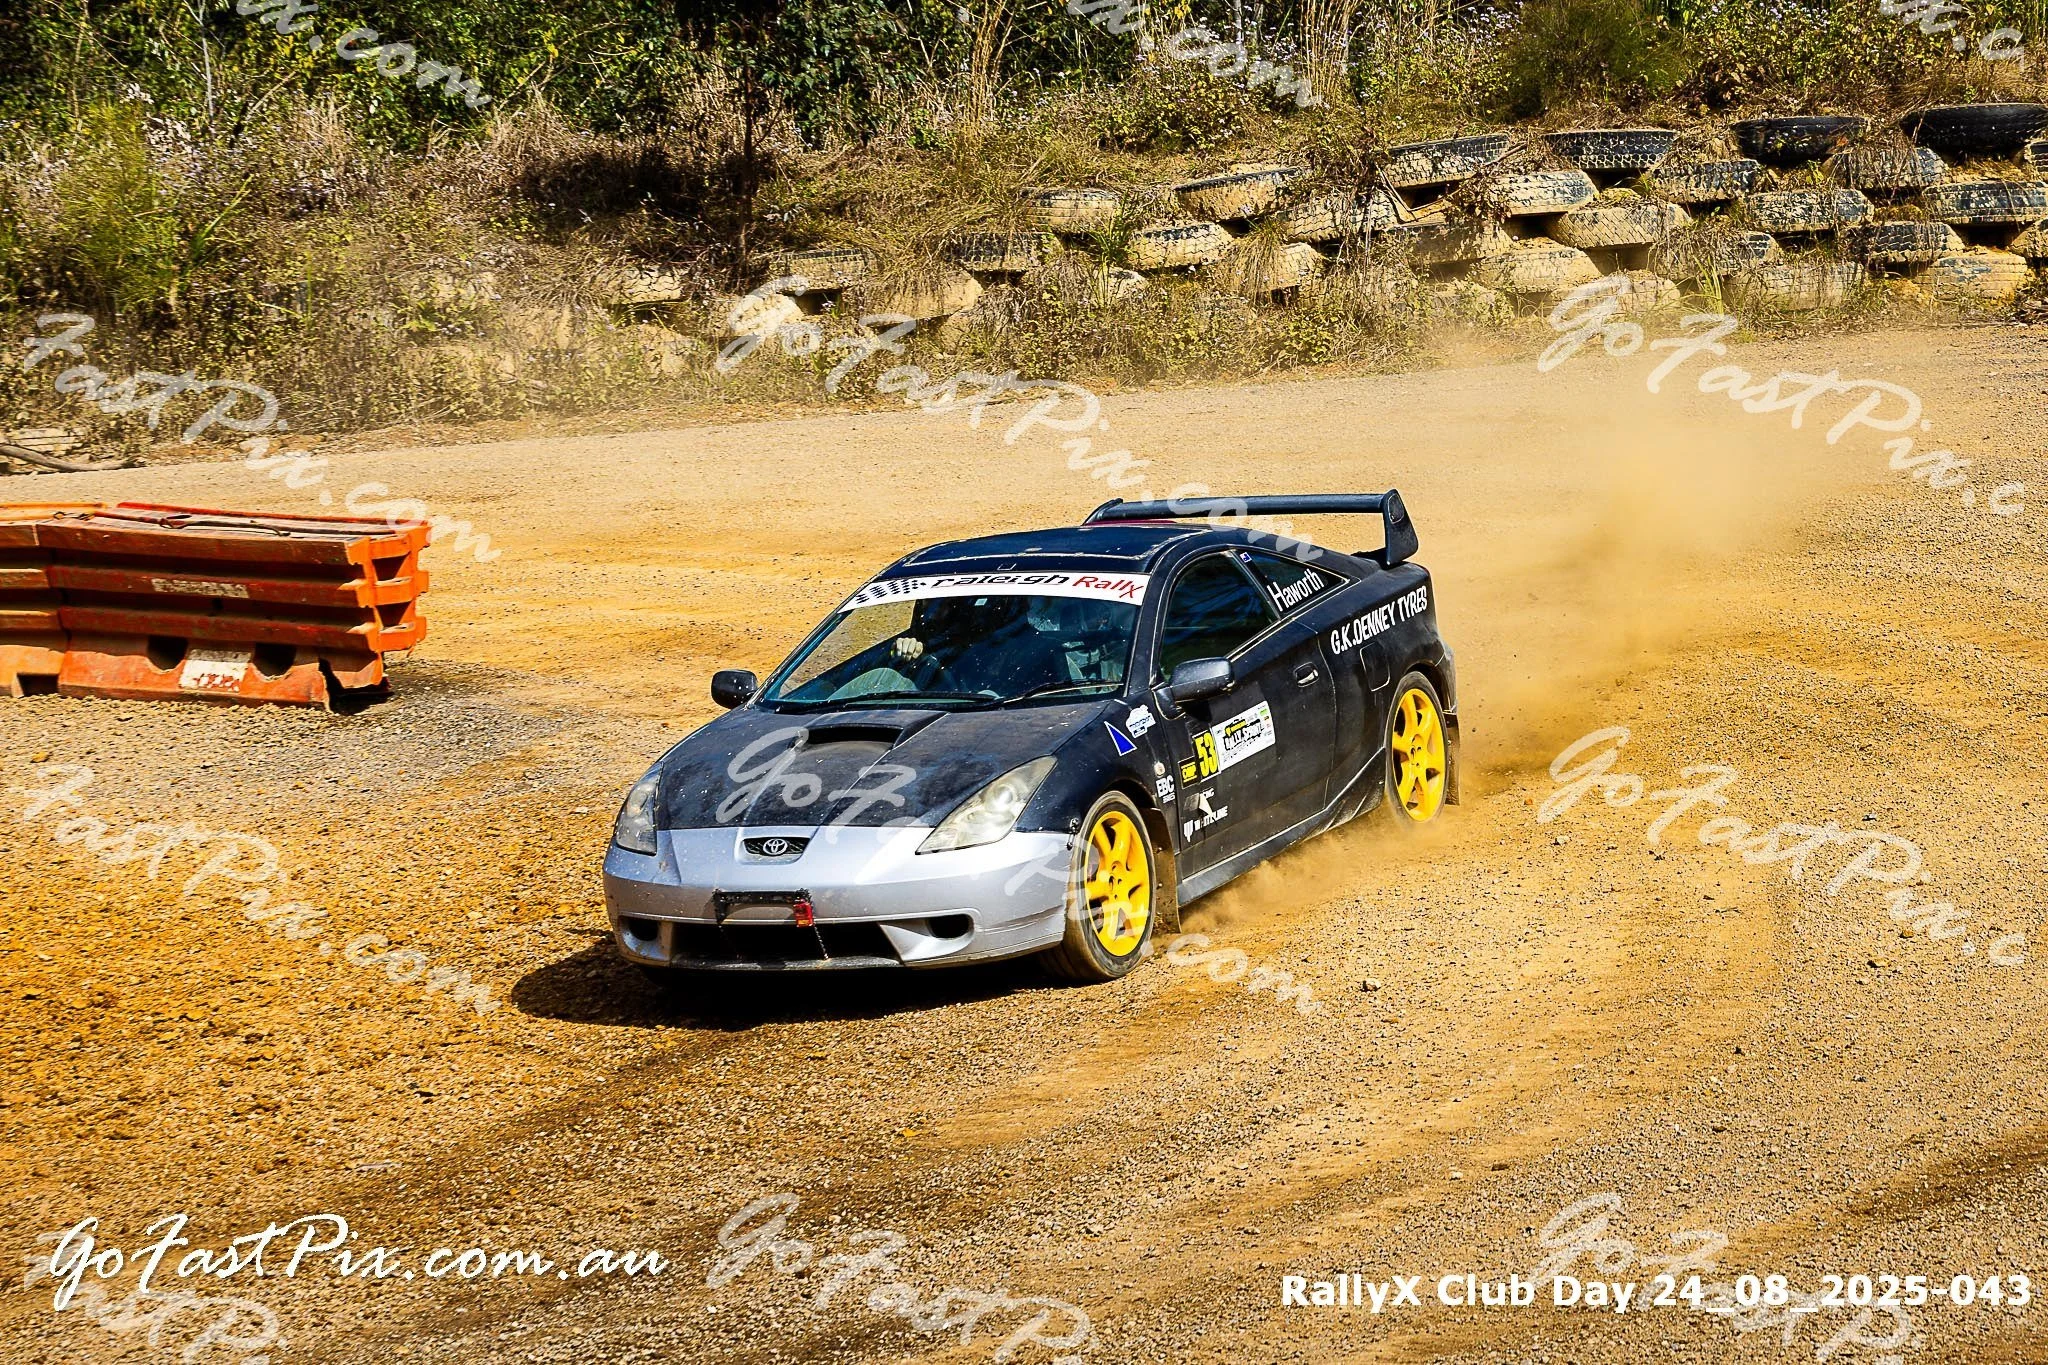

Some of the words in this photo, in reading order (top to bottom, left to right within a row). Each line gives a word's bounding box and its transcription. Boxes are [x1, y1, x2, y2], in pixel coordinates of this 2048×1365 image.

[931, 573, 1070, 589] raleigh
[1267, 568, 1325, 612] Haworth
[1330, 601, 1396, 655] G.K.DENNEY
[1397, 585, 1428, 622] TYRES
[1195, 732, 1219, 778] 53
[1155, 775, 1174, 797] EBC
